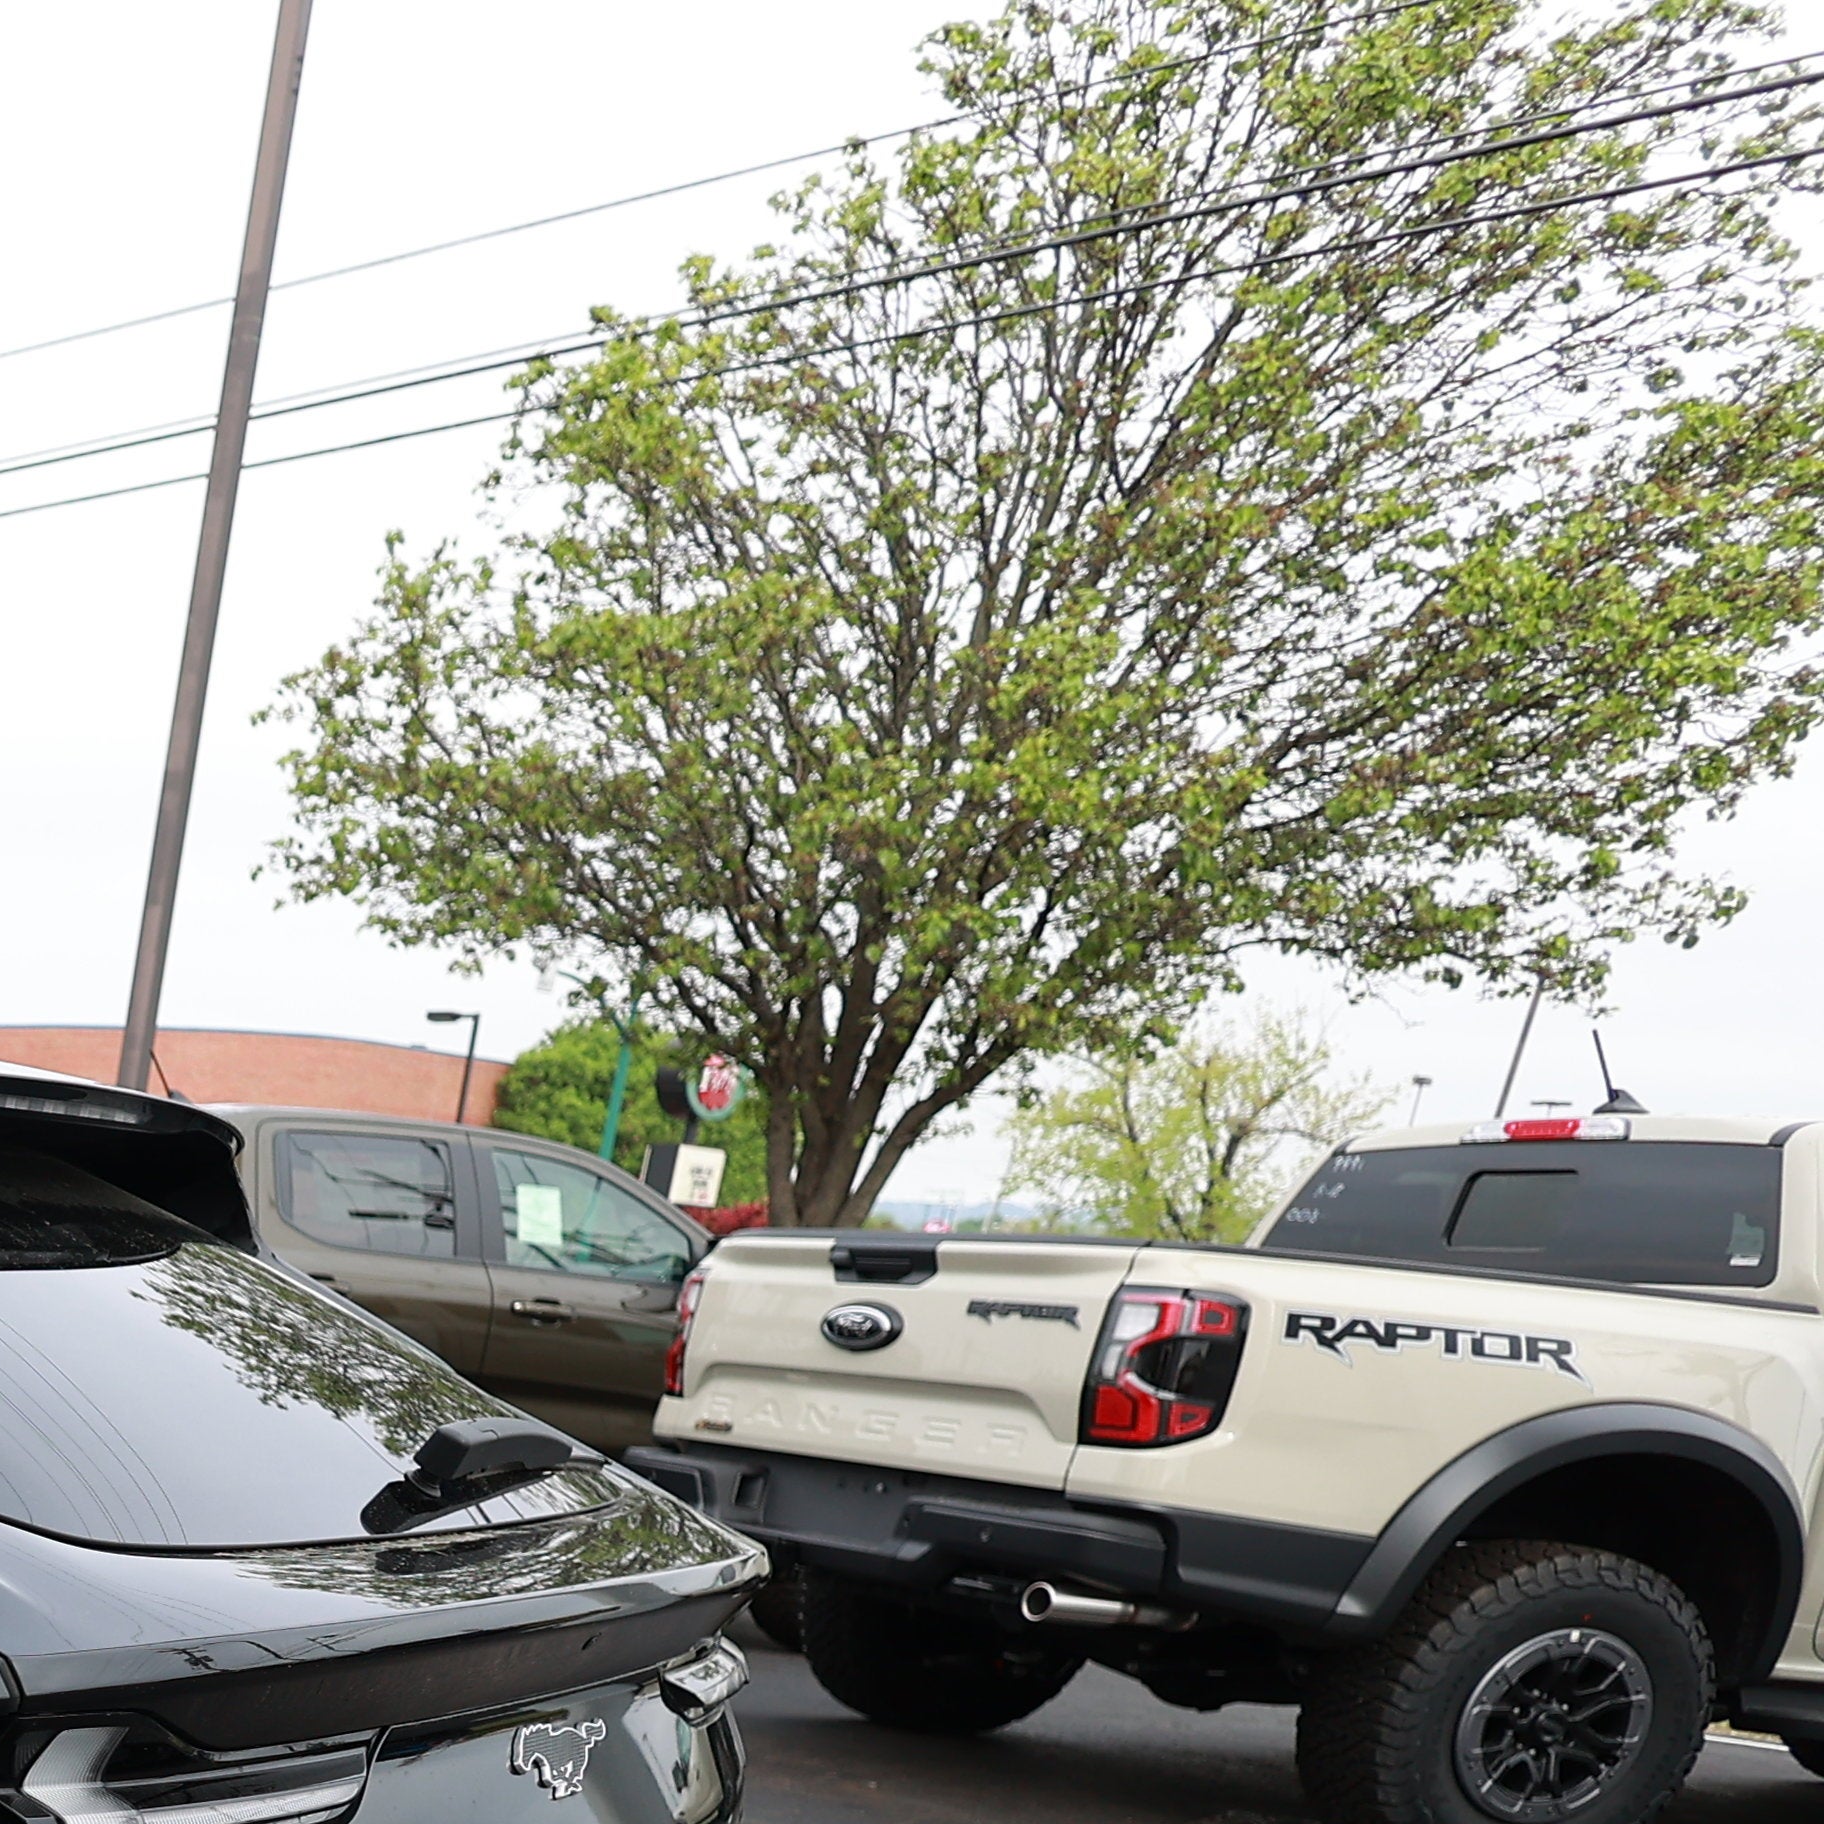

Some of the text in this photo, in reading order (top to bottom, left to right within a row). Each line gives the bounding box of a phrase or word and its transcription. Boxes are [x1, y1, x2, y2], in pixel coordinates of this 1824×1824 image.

[967, 1299, 1081, 1330] RAPTOR
[1283, 1311, 1593, 1391] RAPTOR
[702, 1392, 1028, 1456] RANGER
